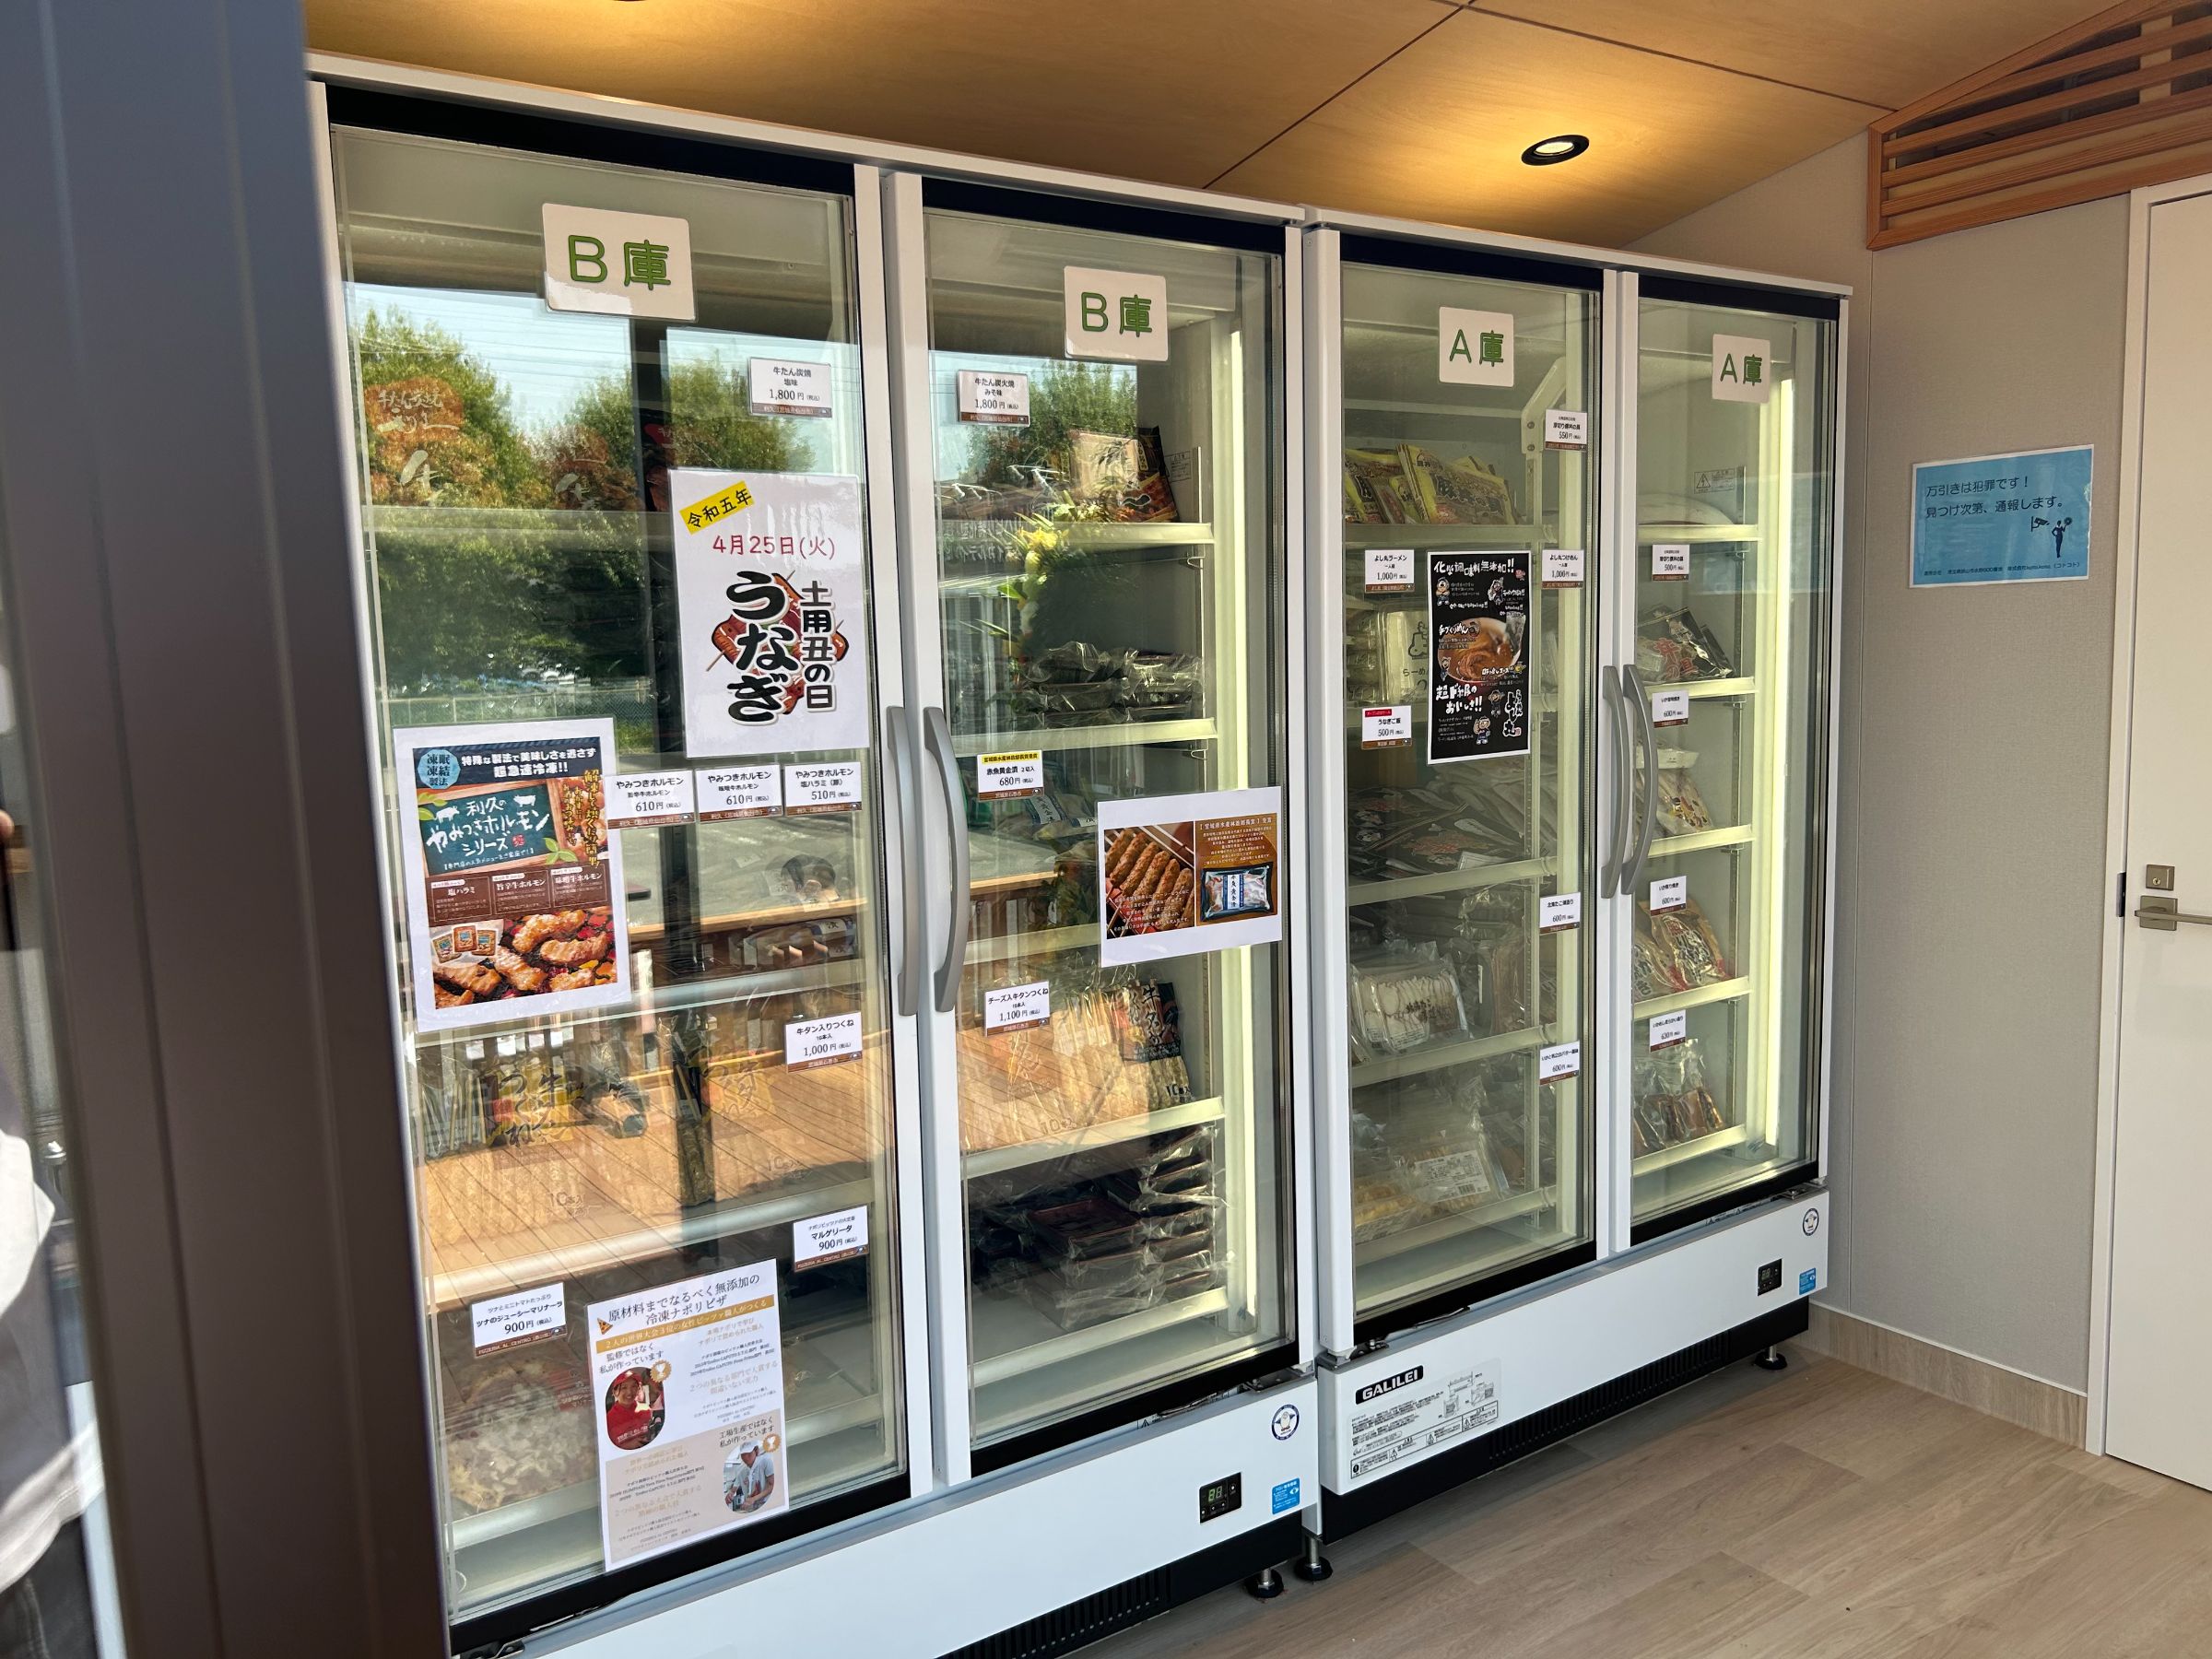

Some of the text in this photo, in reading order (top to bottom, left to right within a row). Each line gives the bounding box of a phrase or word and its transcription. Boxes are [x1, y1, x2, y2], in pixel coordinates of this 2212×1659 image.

[1926, 477, 2029, 498] 万引きは犯罪です!
[688, 488, 753, 529] 令和五年
[1925, 496, 2064, 519] 見つけ次第、通報します。
[712, 535, 835, 560] 4月25日(火)
[725, 571, 800, 724] うなぎ
[800, 580, 833, 710] 土用丑の日
[461, 747, 596, 767] 特殊な製法で美味しさを逃さず
[616, 777, 684, 789] やみつきホルモン
[707, 771, 772, 782] やみつきホルモン
[794, 768, 854, 779] やみつきホルモン
[999, 777, 1020, 785] 680円
[726, 794, 753, 805] 610円
[811, 790, 836, 800] 510円
[465, 795, 507, 817] 利久の
[635, 801, 664, 812] 610円
[426, 809, 550, 853] やみつきホルモン
[462, 836, 509, 857] シリーズ
[796, 1019, 854, 1035] 牛タン入りつくね
[818, 1238, 842, 1251] 900円
[607, 1275, 759, 1323] 原材料までなるべく無添加の
[646, 1294, 728, 1327] 冷凍ナポリピザ
[504, 1320, 534, 1335] 900円
[599, 1350, 664, 1374] 私が作っています
[606, 1342, 653, 1362] 監修ではなく
[1362, 1369, 1419, 1401] GALILEI
